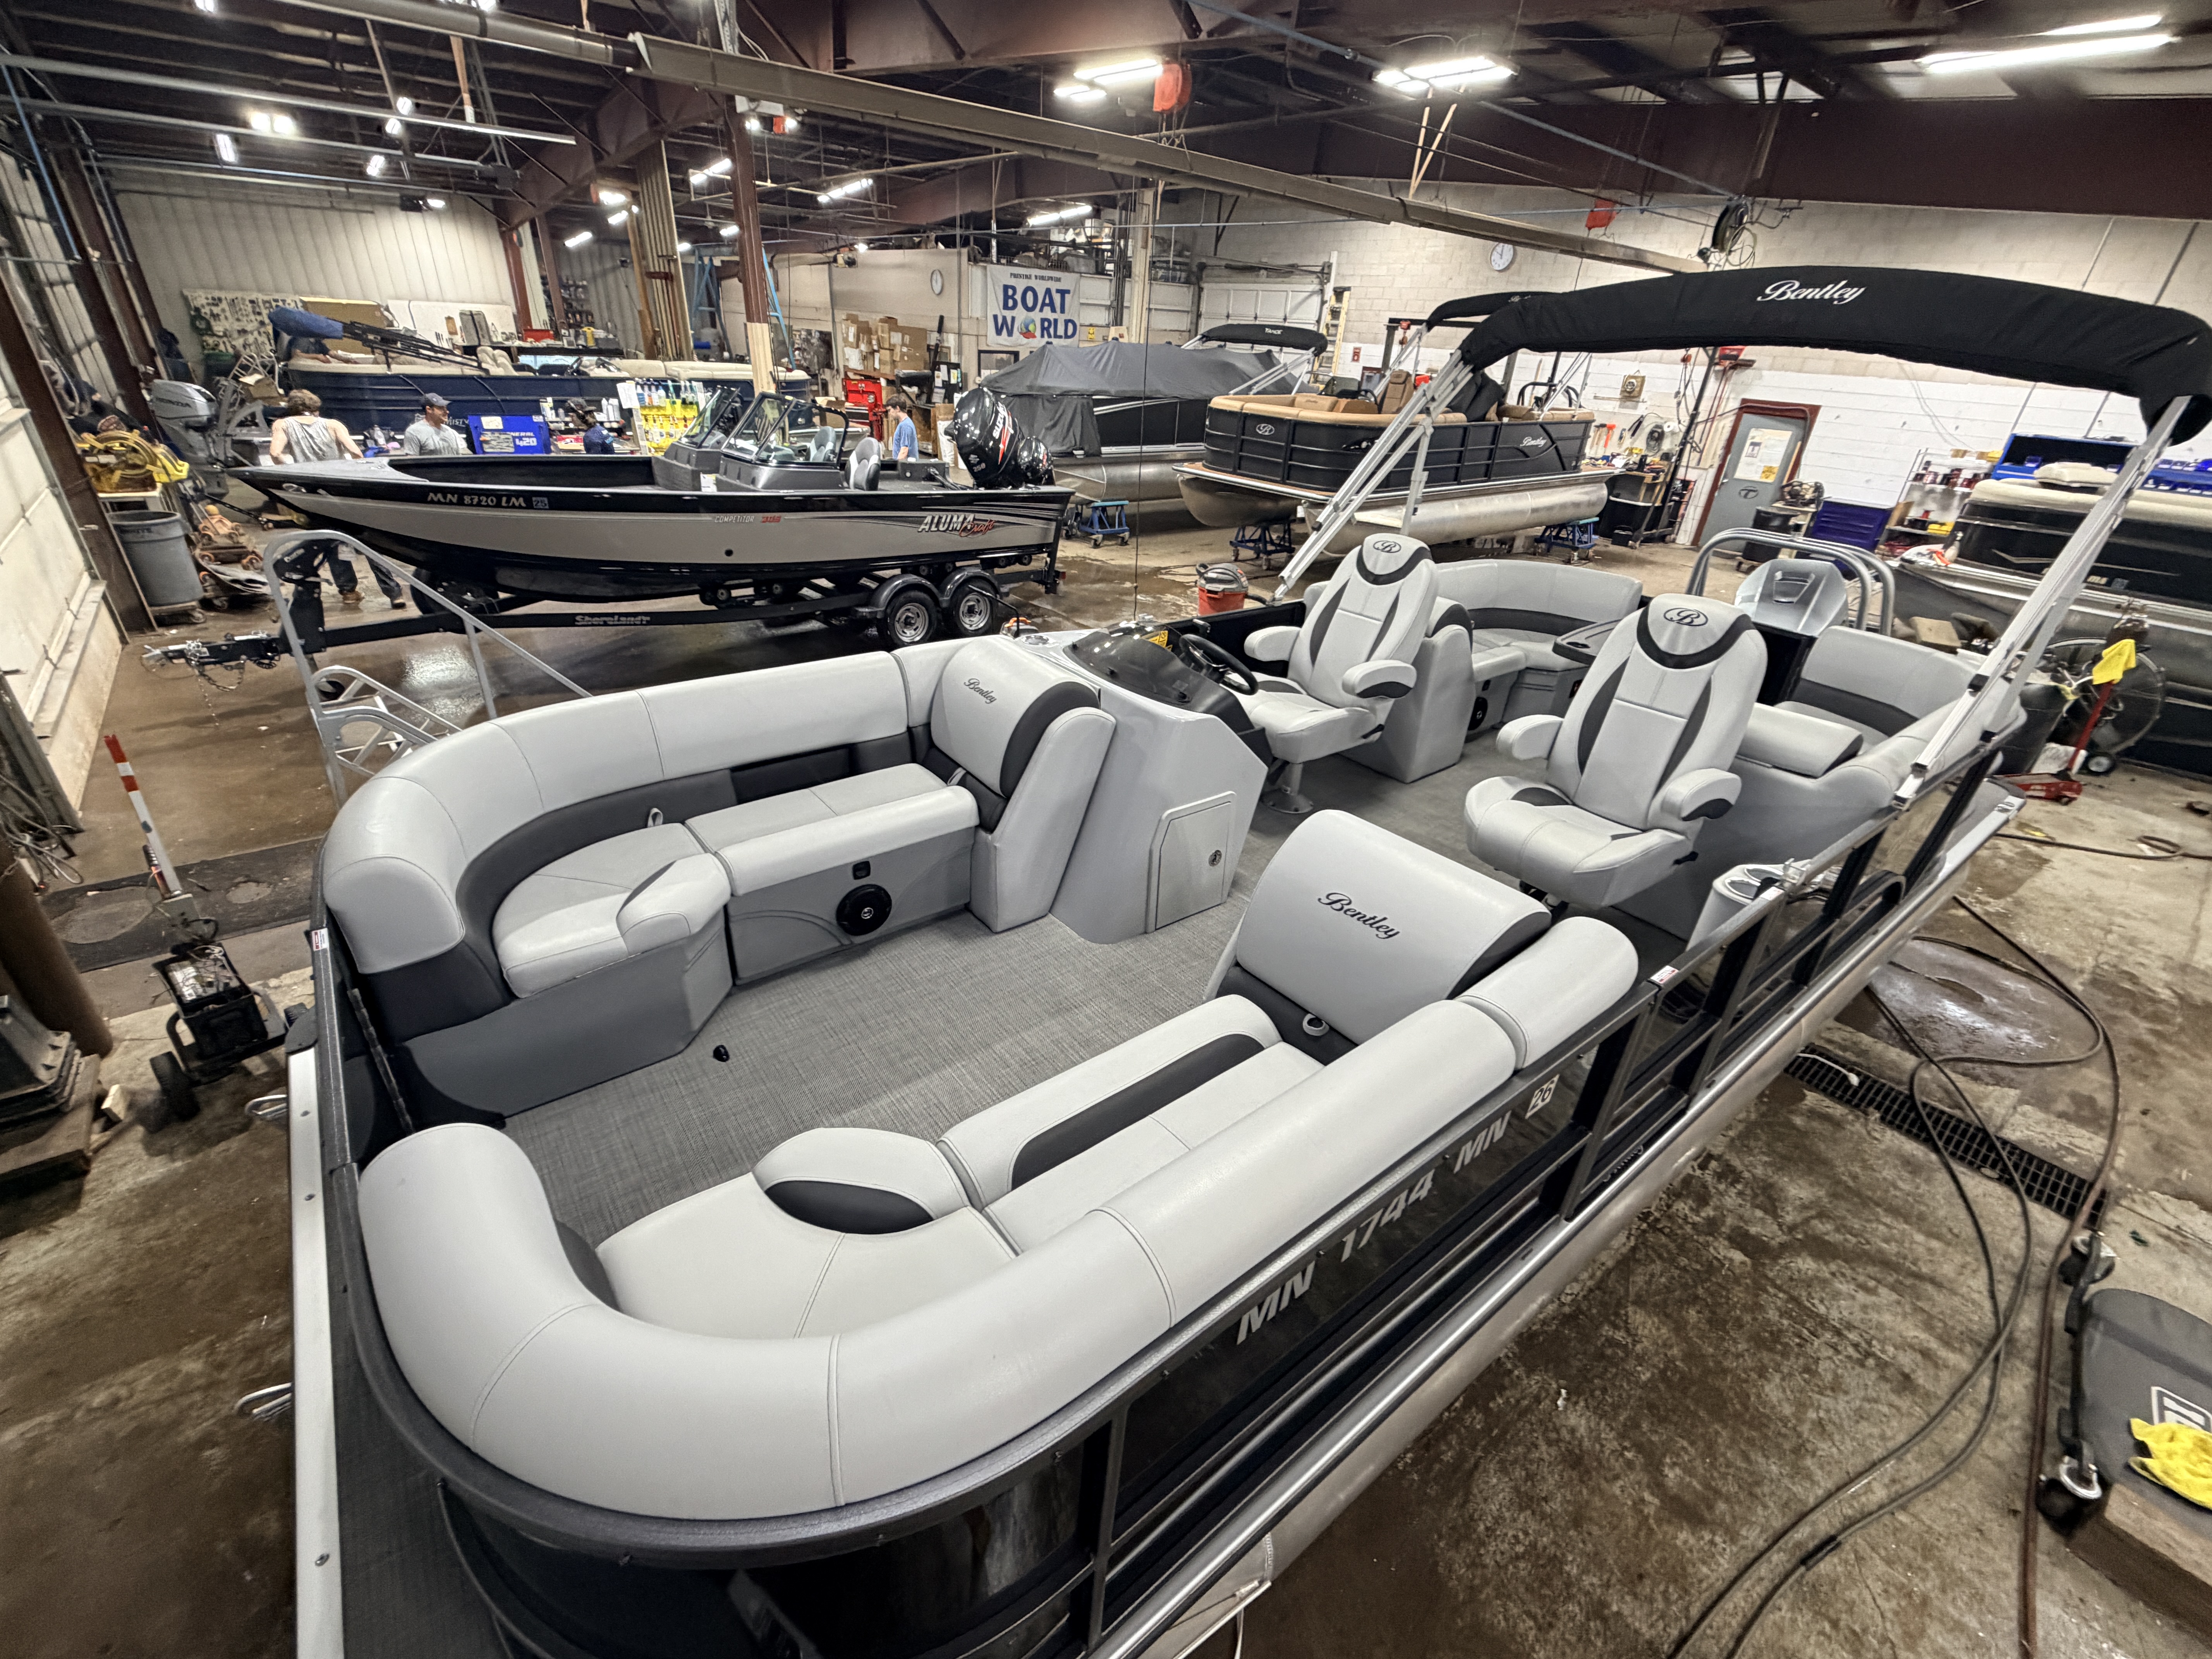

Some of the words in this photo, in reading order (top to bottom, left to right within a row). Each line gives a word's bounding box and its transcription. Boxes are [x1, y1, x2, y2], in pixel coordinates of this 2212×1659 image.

[1002, 284, 1070, 314] BOAT
[1757, 280, 1867, 305] Bentley
[515, 438, 538, 447] 420
[427, 493, 457, 503] MN
[464, 496, 496, 506] 8720
[501, 496, 526, 507] LM
[963, 678, 997, 704] Bentley
[1317, 892, 1400, 939] Bentley
[1237, 1260, 1316, 1345] MN
[1340, 1169, 1435, 1262] 1744
[1453, 1111, 1512, 1174] MN
